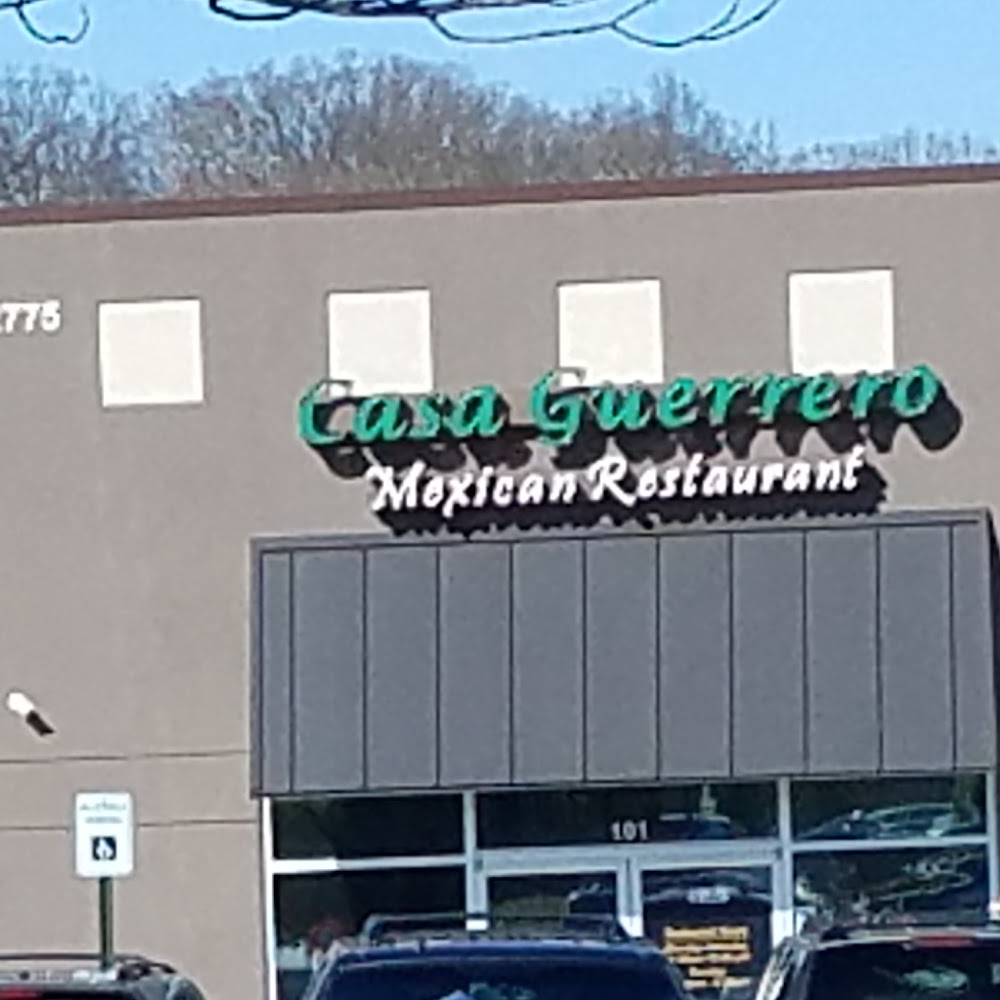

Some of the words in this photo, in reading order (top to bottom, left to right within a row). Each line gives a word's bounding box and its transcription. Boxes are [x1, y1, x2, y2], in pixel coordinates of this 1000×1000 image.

[299, 379, 508, 445] Casa
[529, 365, 939, 447] Guerrero
[365, 460, 577, 518] Mexican
[587, 445, 867, 508] Restaurant
[611, 820, 648, 841] 101
